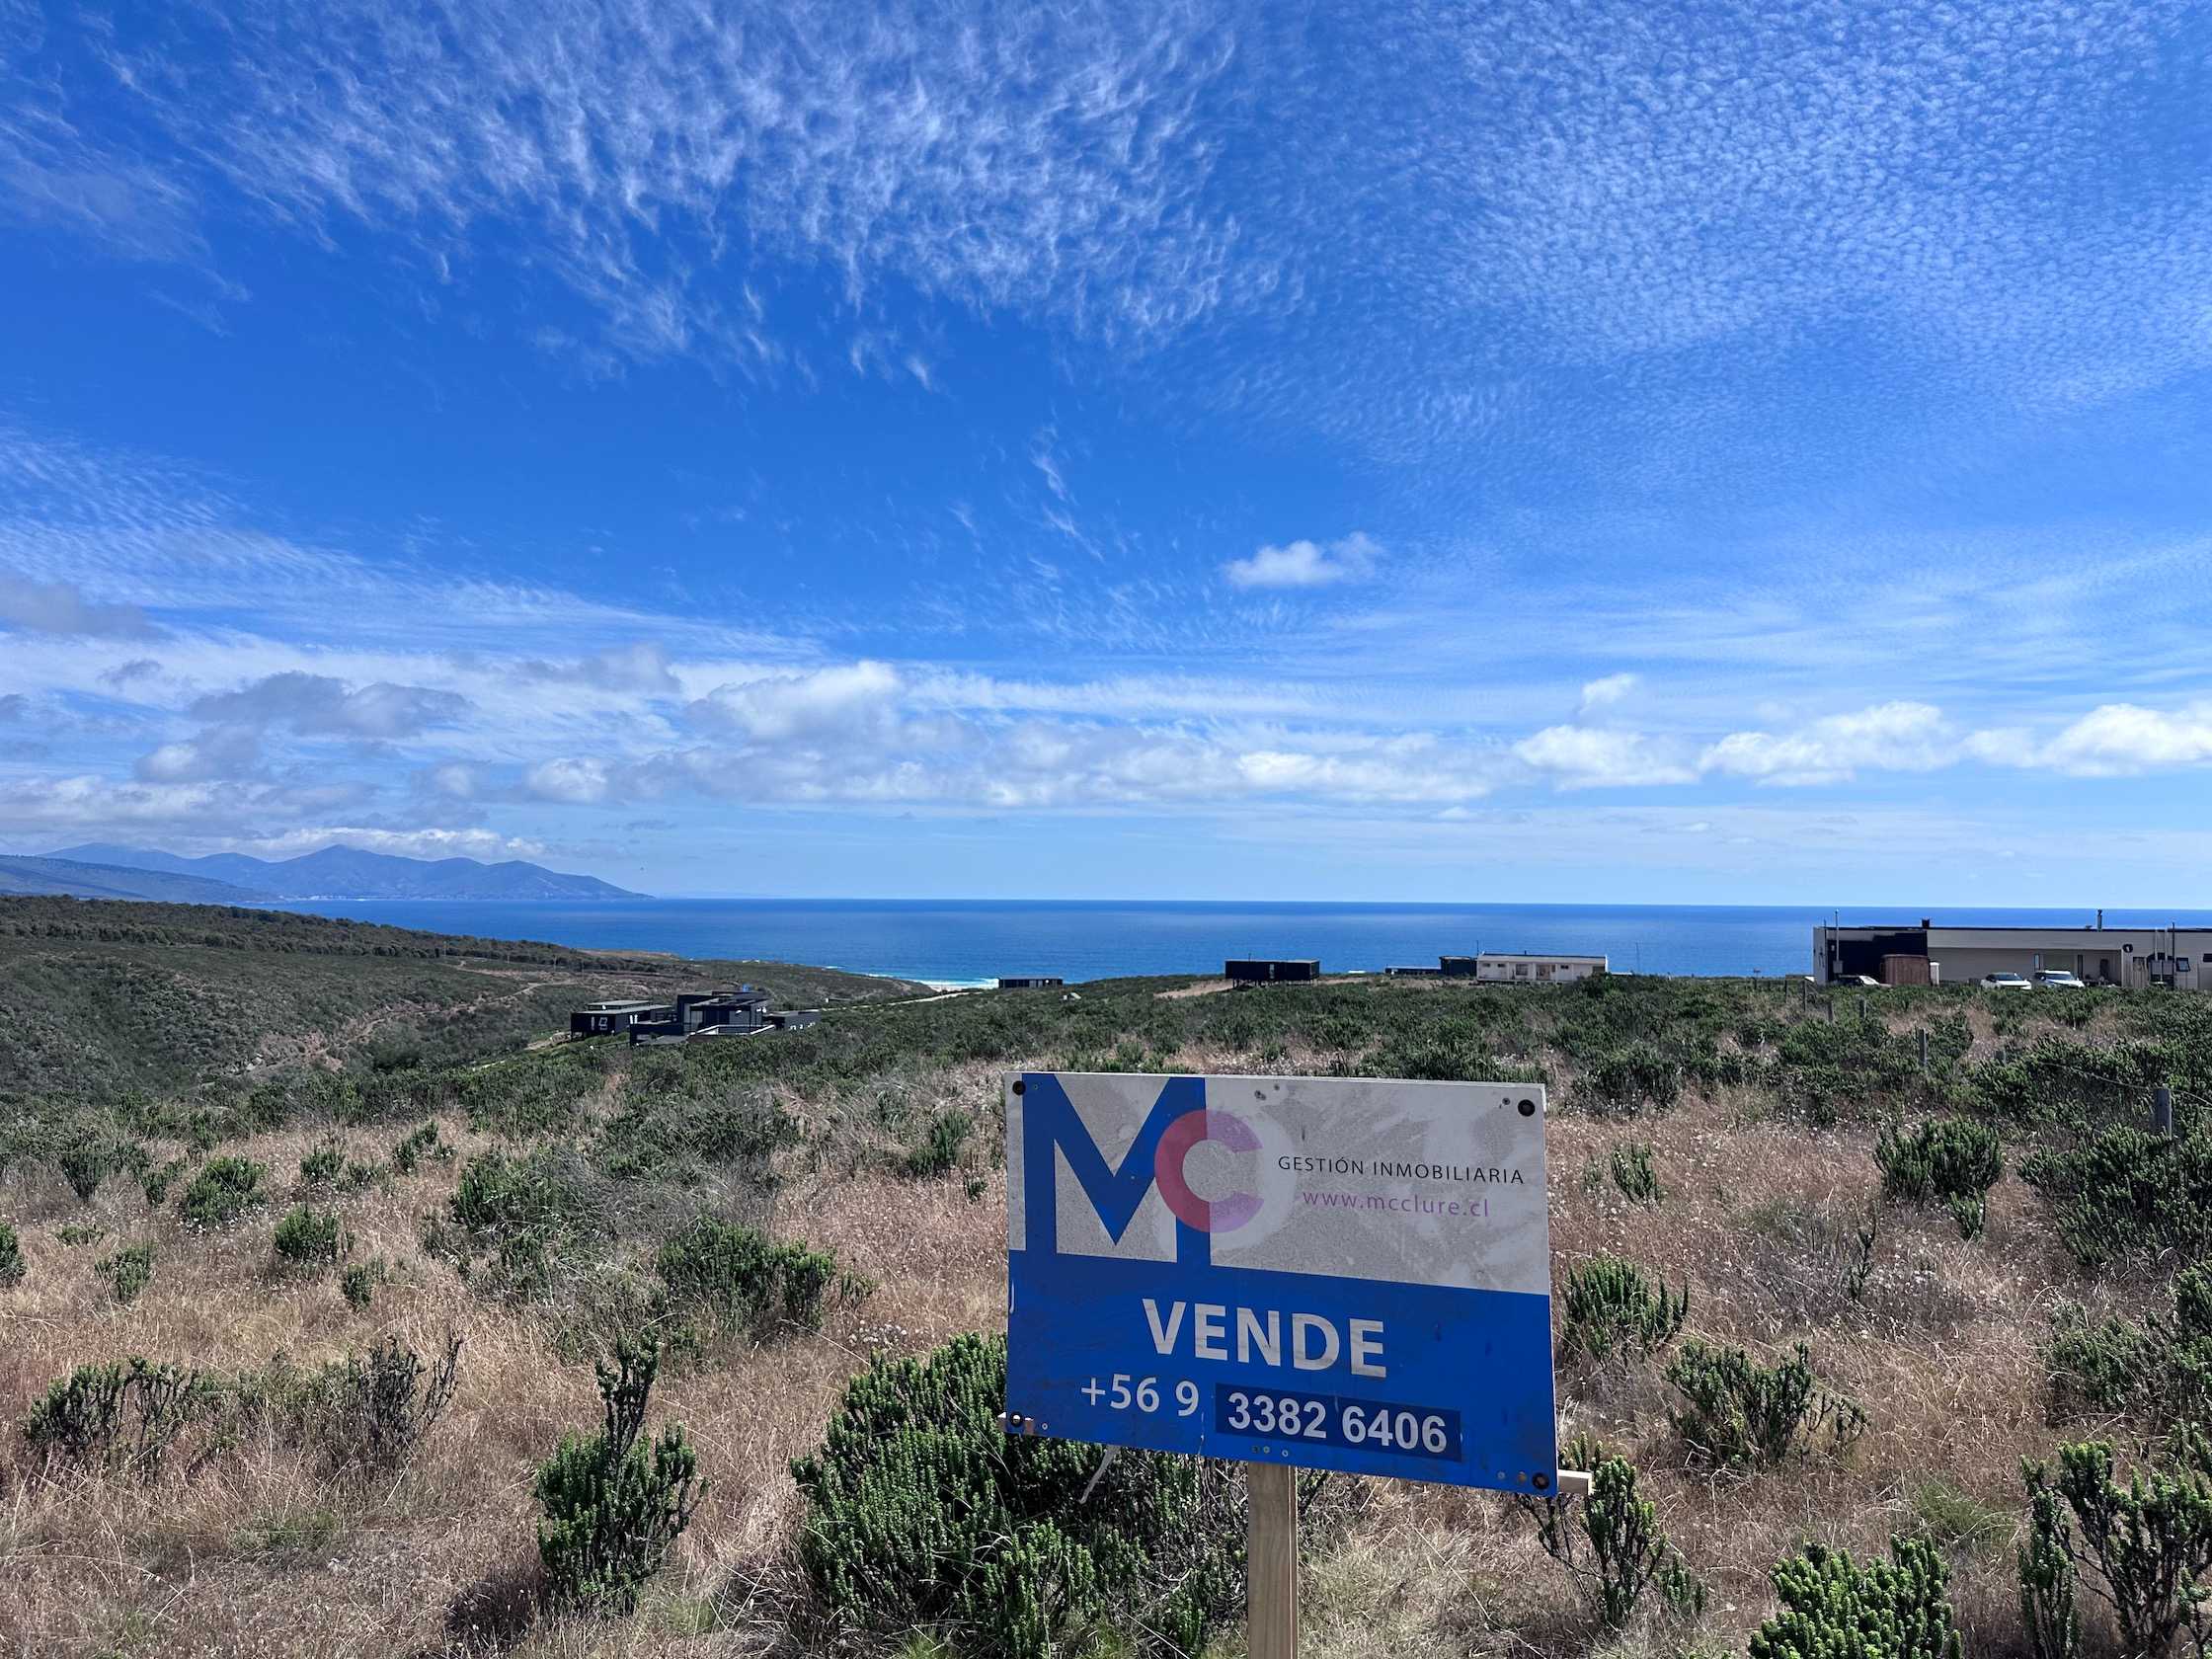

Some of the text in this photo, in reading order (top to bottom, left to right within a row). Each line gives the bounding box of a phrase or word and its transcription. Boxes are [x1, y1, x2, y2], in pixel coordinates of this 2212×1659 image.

[1278, 1155, 1525, 1184] GESTIÓN INMOBILIARIA
[1303, 1191, 1489, 1218] www.mcclure.cl
[1142, 1298, 1387, 1379] VENDE
[1080, 1373, 1448, 1454] +56 9 3382 6406
